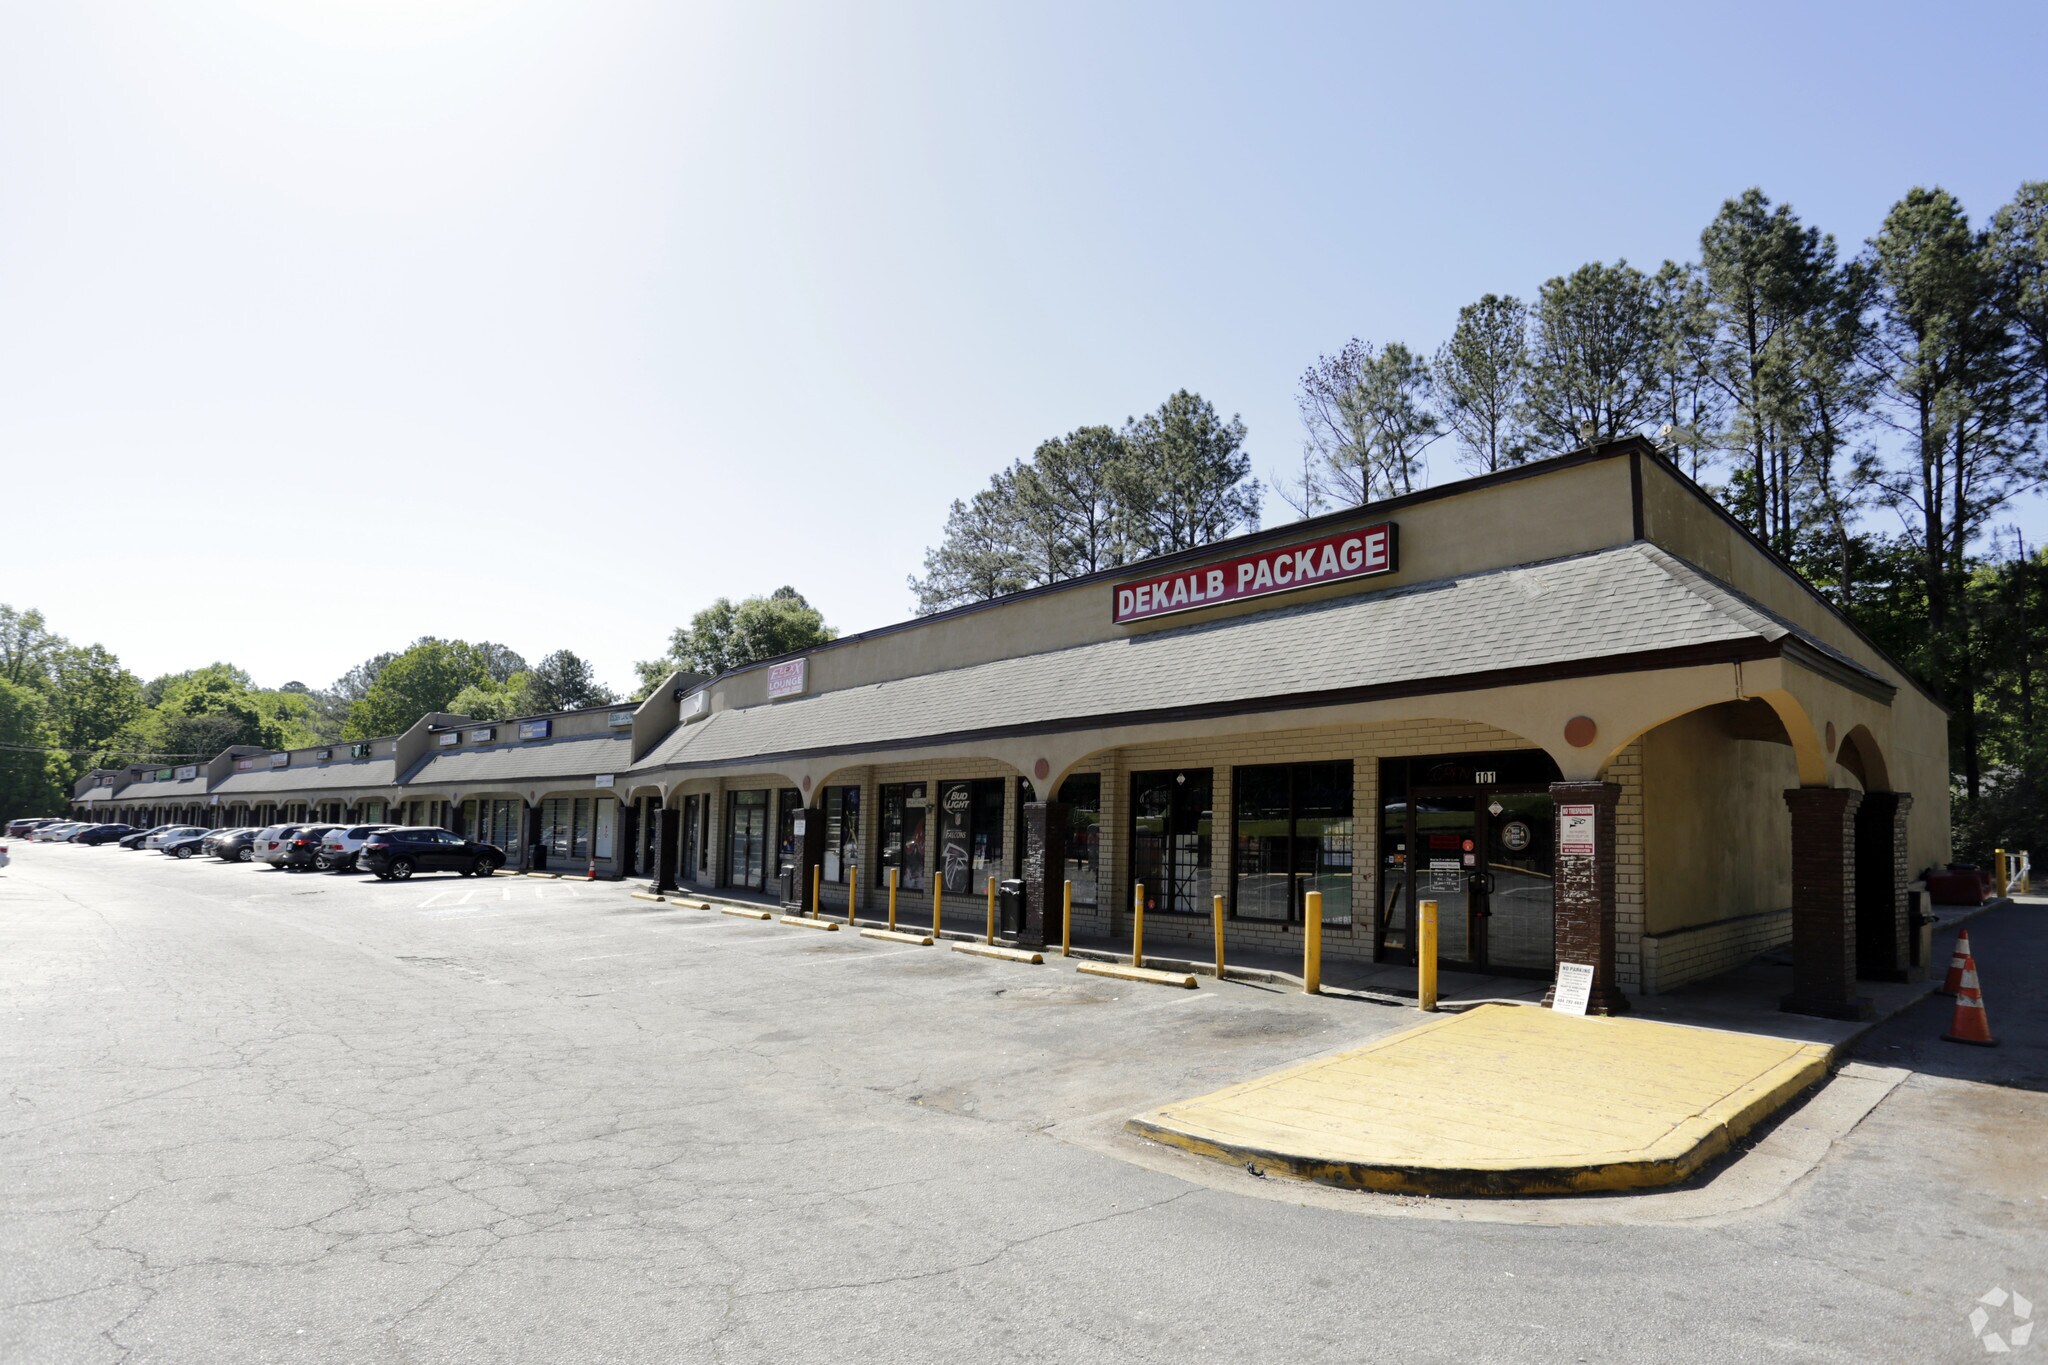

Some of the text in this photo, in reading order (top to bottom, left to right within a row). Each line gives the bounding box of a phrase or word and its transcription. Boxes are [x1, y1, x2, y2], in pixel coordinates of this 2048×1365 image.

[1118, 532, 1386, 617] DEKALB PACKAGE
[769, 676, 802, 690] LOUNGE
[1477, 772, 1495, 783] 101
[950, 792, 968, 800] BUD
[947, 800, 970, 809] LIGHT
[945, 830, 966, 838] FALCONS
